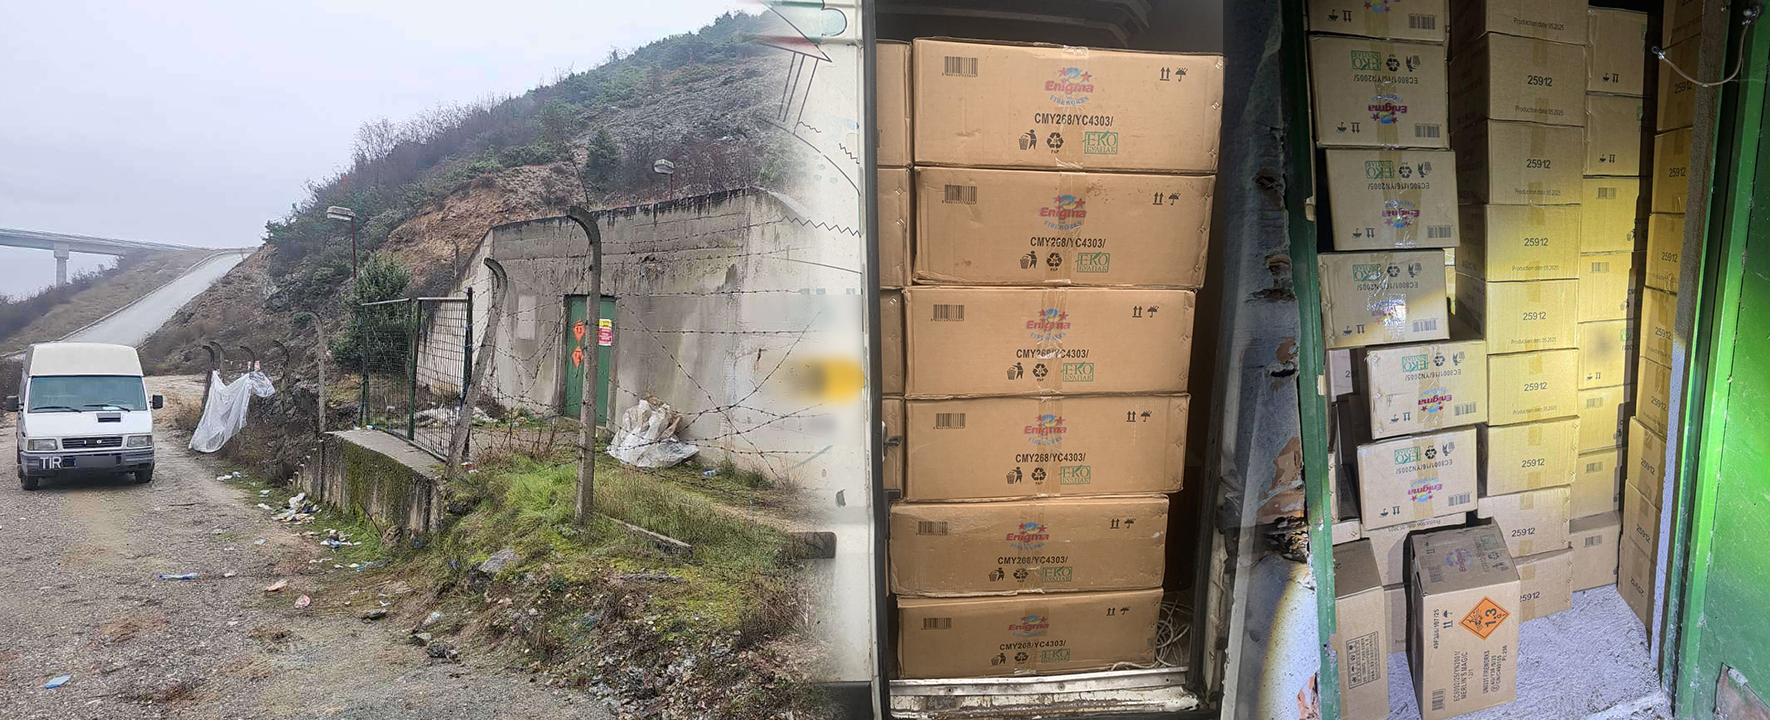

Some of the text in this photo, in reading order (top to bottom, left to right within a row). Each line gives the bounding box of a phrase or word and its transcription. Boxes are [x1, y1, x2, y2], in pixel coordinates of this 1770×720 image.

[1513, 17, 1537, 27] Production
[1044, 78, 1094, 95] Enigma
[1527, 75, 1553, 87] 25912
[1368, 102, 1408, 114] Enigma
[1515, 105, 1537, 115] Production
[1034, 112, 1114, 127] CMY268/YC4303/
[1526, 158, 1551, 169] 25912
[1669, 166, 1687, 178] 25912
[1039, 205, 1087, 219] Enigma
[1030, 236, 1107, 249] CMY268/YC4303/
[1524, 237, 1549, 247] 25912
[1661, 251, 1678, 263] 25912
[1522, 311, 1547, 321] 25912
[1025, 319, 1071, 333] Enigma
[1654, 326, 1672, 341] 25912
[1524, 381, 1548, 392] 25912
[1417, 394, 1453, 406] Enigma
[1650, 395, 1667, 412] 25912
[1024, 424, 1067, 438] Enigma
[40, 456, 63, 470] TIR
[1015, 452, 1086, 464] CMY268/YC4303/
[1521, 457, 1546, 468] 25912
[1640, 457, 1656, 476] 25912
[1407, 483, 1443, 496] Enigma
[1006, 531, 1050, 544] Enigma
[1511, 527, 1536, 537] 25912
[1636, 524, 1651, 544] 25912
[997, 555, 1068, 566] CMY268/YC4303/
[1484, 607, 1498, 628] 1.3
[1008, 622, 1050, 633] Enigma
[1000, 639, 1067, 651] CMY268/YC4303/
